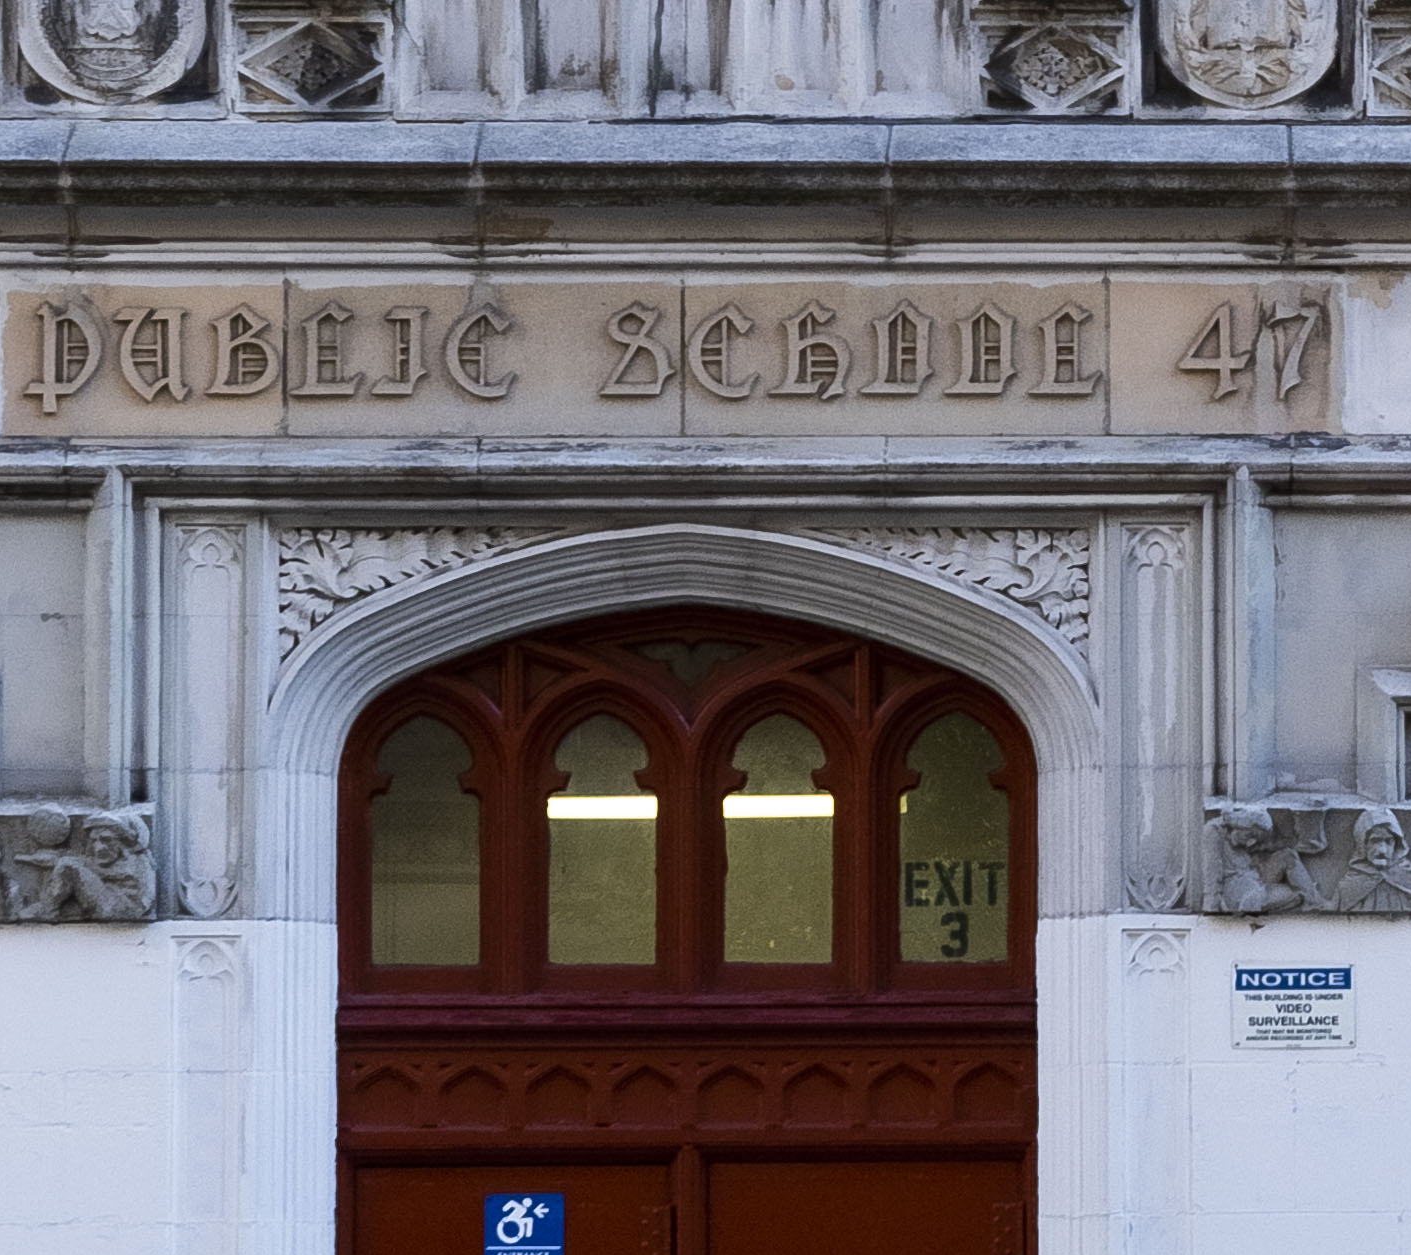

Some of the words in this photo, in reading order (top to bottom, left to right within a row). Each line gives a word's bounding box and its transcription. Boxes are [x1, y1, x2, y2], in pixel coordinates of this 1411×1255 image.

[22, 299, 519, 414] PUBLIC
[598, 298, 1102, 400] SCHOOL
[1177, 302, 1321, 401] 47
[905, 861, 1005, 907] EXIT
[941, 911, 969, 958] 3
[1241, 971, 1346, 987] NOTICE
[1304, 993, 1313, 1001] IS
[1314, 993, 1343, 1001] UNDER
[1275, 1003, 1312, 1014] VIDEO
[1248, 1015, 1340, 1026] SURVEILLANCE
